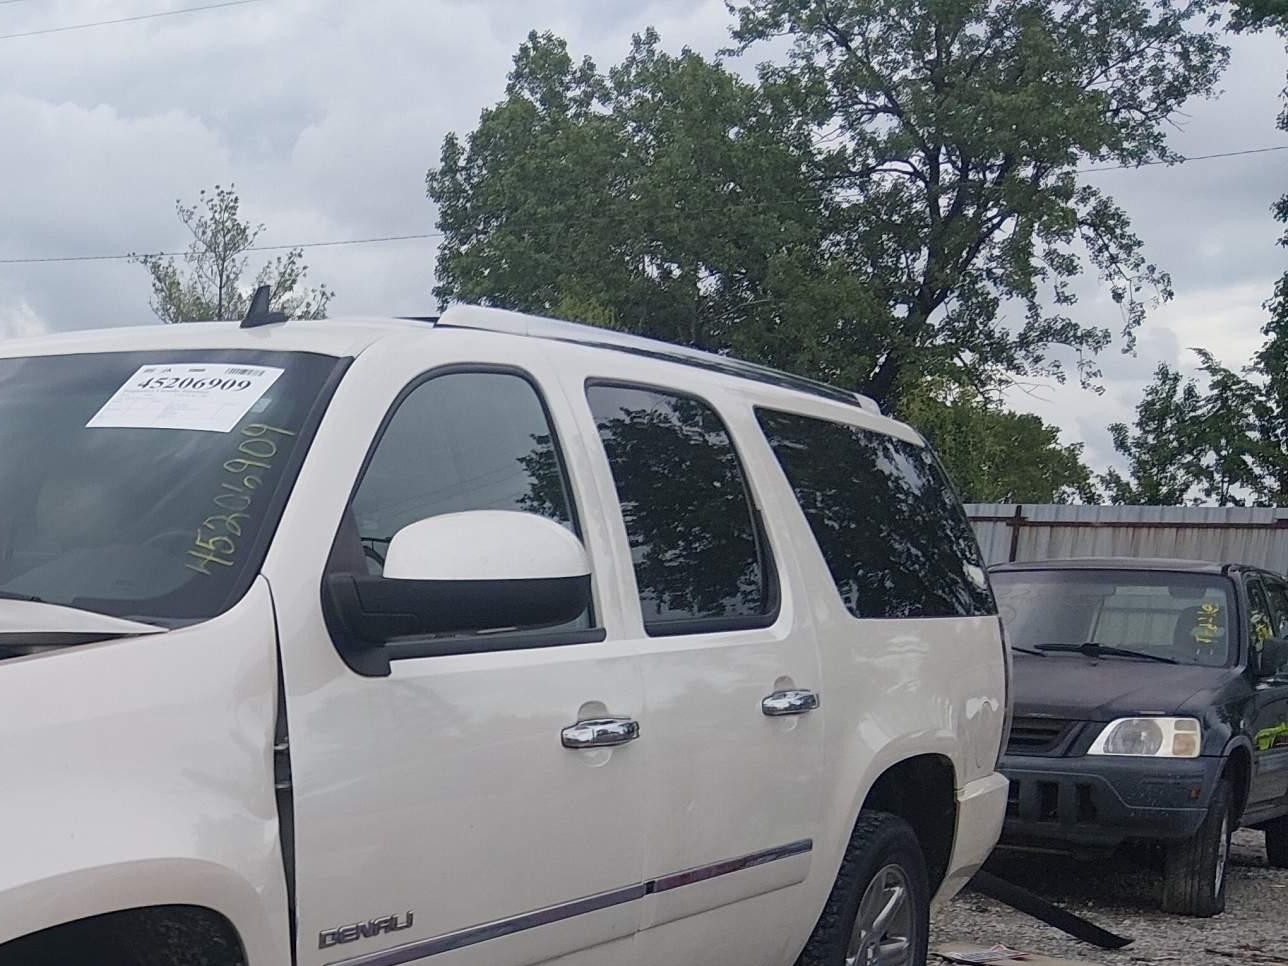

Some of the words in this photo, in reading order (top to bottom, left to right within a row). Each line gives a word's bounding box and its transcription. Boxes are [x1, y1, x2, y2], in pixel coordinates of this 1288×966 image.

[137, 376, 251, 392] 45206909
[186, 423, 295, 574] 45206909
[318, 911, 413, 949] DENALI
